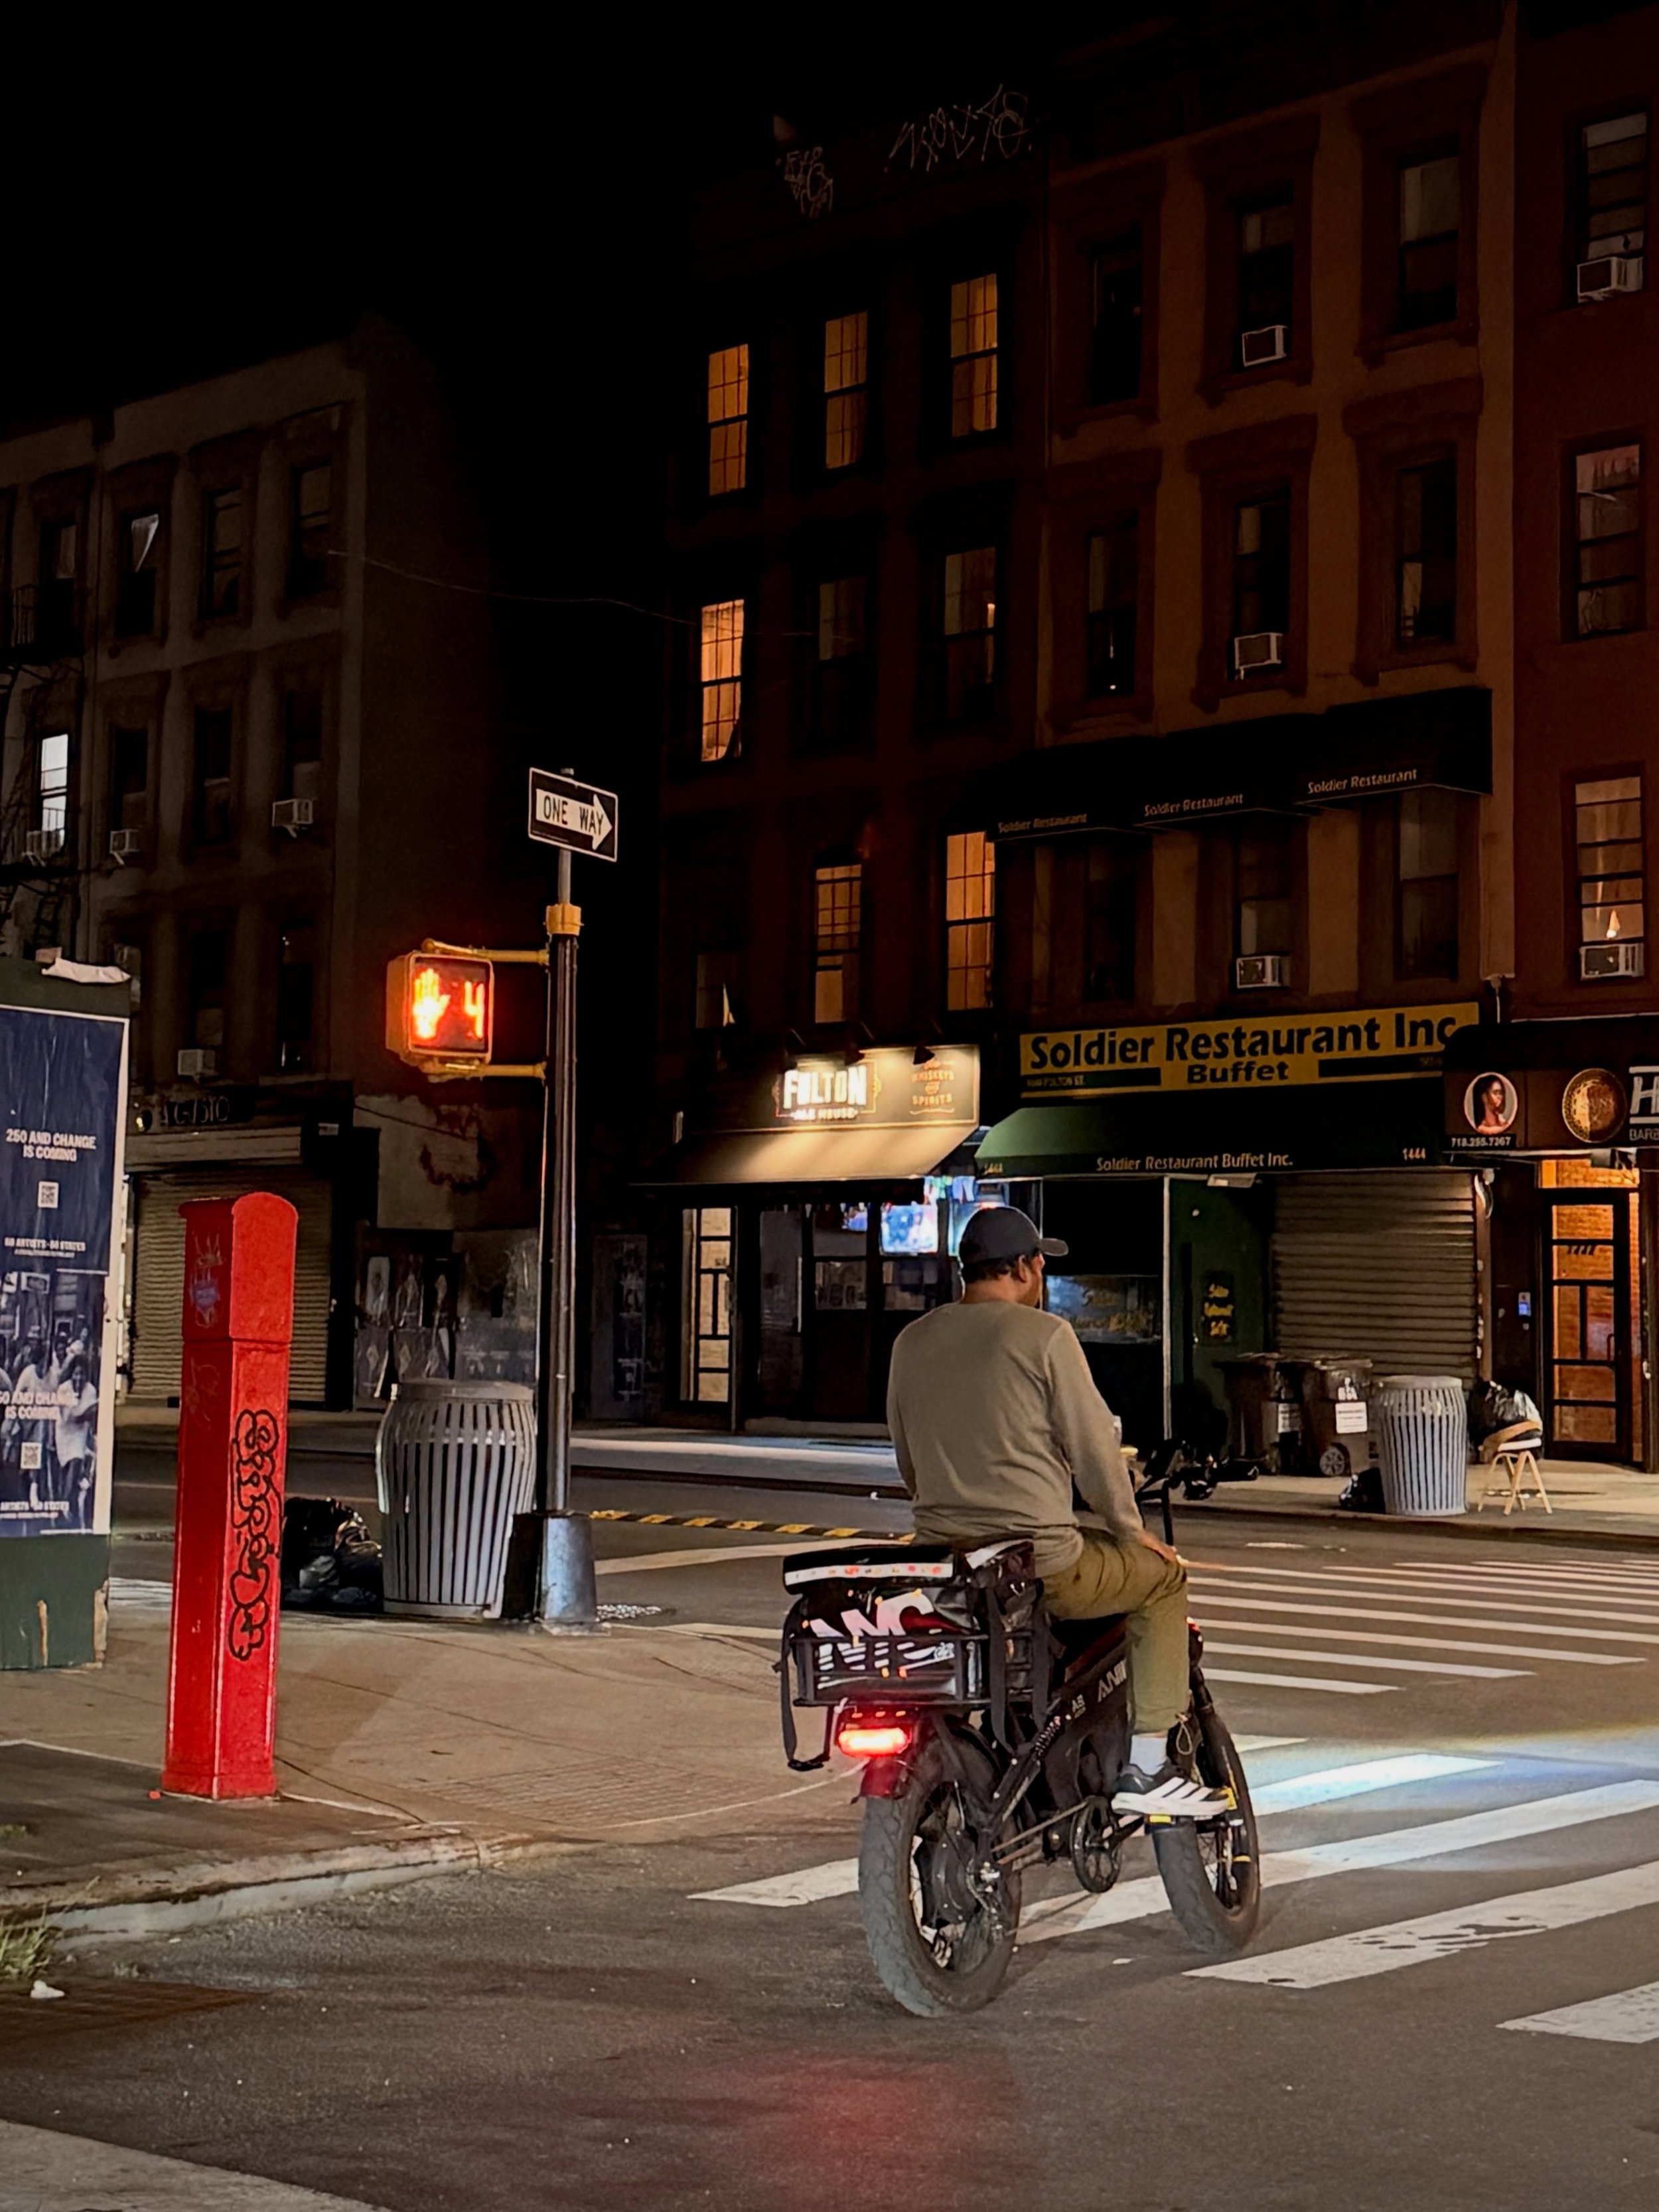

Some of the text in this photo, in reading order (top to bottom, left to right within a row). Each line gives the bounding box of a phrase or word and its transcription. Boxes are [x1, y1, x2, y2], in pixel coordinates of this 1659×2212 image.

[1307, 769, 1417, 794] Soldier Restaurant
[543, 795, 603, 836] ONE WAY
[1144, 794, 1243, 817] Soldier Restaurant
[1033, 813, 1088, 828] Restaurant
[1031, 1013, 1457, 1070] Soldier Restaurant Inc
[1187, 1061, 1289, 1084] Buffet
[783, 1065, 867, 1109] FULTON
[912, 1094, 952, 1106] SPIRITS
[6, 1128, 28, 1143] 250
[29, 1131, 51, 1145] AND
[23, 1145, 77, 1161] IS COMING
[1096, 1152, 1294, 1172] Soldier Restaurant Buffet Inc.
[1402, 1148, 1426, 1161] 1444
